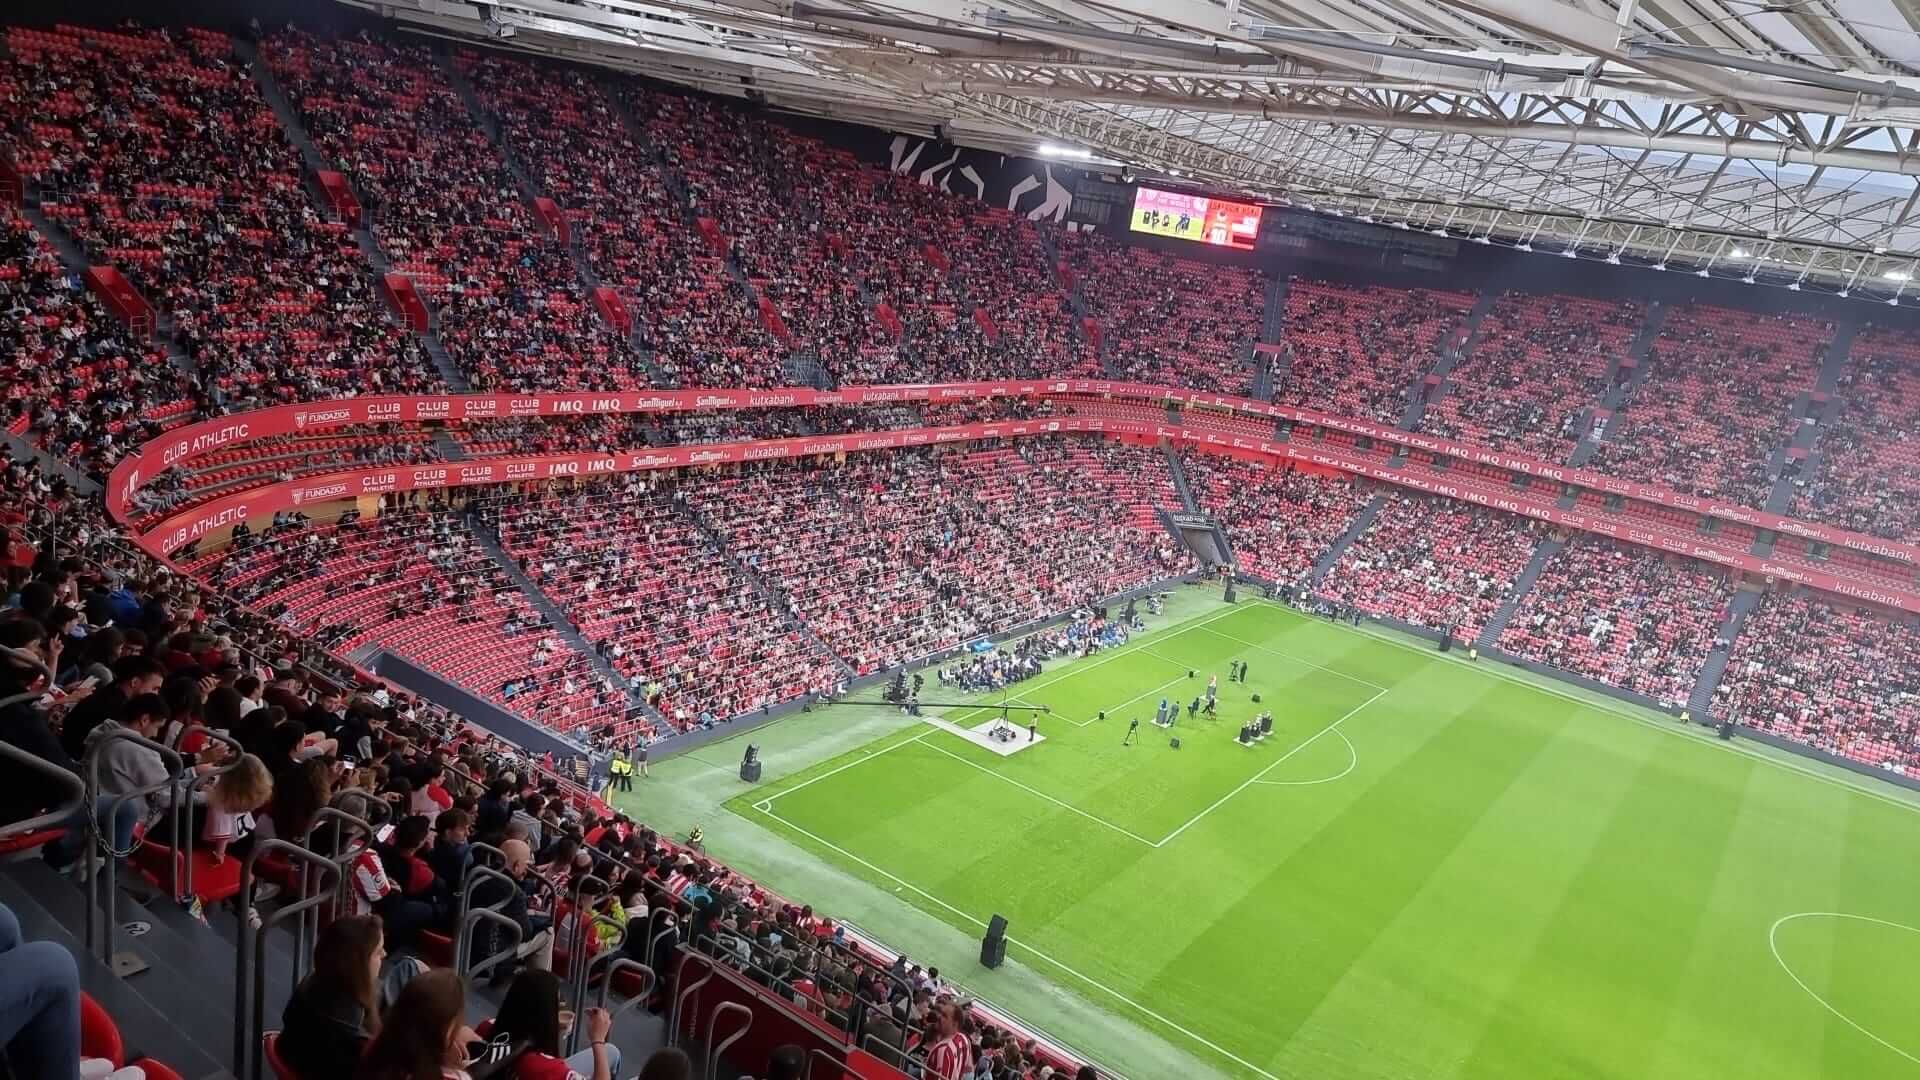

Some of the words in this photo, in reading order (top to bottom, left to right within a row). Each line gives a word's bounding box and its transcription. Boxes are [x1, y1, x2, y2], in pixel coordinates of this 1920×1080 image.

[750, 394, 794, 406] kutxabank
[863, 391, 899, 401] kutxabank
[367, 403, 401, 414] CLUB
[416, 401, 449, 412] CLUB
[465, 400, 496, 410] CLUB
[510, 399, 540, 408] CLUB
[553, 400, 583, 413] IMQ
[592, 398, 620, 411] IMQ
[367, 413, 400, 421] ATHLETIC
[1322, 418, 1347, 428] DIGI
[1350, 424, 1376, 435] DIGI
[1382, 431, 1408, 442] DIGI
[163, 441, 188, 464] CLUB
[192, 424, 249, 452] ATHLETIC
[804, 442, 844, 455] kutxabank
[858, 438, 894, 449] kutxabank
[1411, 438, 1438, 449] DIGI
[744, 446, 789, 459] kutxabank
[1445, 446, 1469, 457] IMQ
[1313, 455, 1339, 466] DIGI
[1476, 453, 1500, 465] IMQ
[506, 464, 535, 473] CLUB
[549, 462, 579, 475] IMQ
[588, 459, 615, 471] IMQ
[1341, 462, 1367, 473] DIGI
[1506, 460, 1530, 472] IMQ
[414, 470, 447, 481] CLUB
[461, 466, 492, 477] CLUB
[1374, 470, 1400, 481] DIGI
[1537, 467, 1562, 480] IMQ
[362, 474, 396, 486] CLUB
[414, 479, 446, 487] ATHLETIC
[1402, 477, 1429, 488] DIGI
[1574, 474, 1598, 483] CLUB
[362, 484, 394, 493] ATHLETIC
[1434, 484, 1457, 495] IMQ
[1605, 480, 1630, 490] CLUB
[1464, 492, 1488, 503] IMQ
[1639, 488, 1664, 498] CLUB
[1494, 499, 1518, 511] IMQ
[1673, 496, 1699, 506] CLUB
[1525, 506, 1550, 519] IMQ
[1561, 513, 1585, 523] CLUB
[162, 528, 187, 553] CLUB
[191, 505, 247, 541] ATHLETIC
[1592, 521, 1617, 532] CLUB
[1629, 530, 1654, 540] CLUB
[1662, 538, 1688, 549] CLUB
[1844, 537, 1913, 562] kutxabank
[1834, 582, 1904, 608] kutxabank
